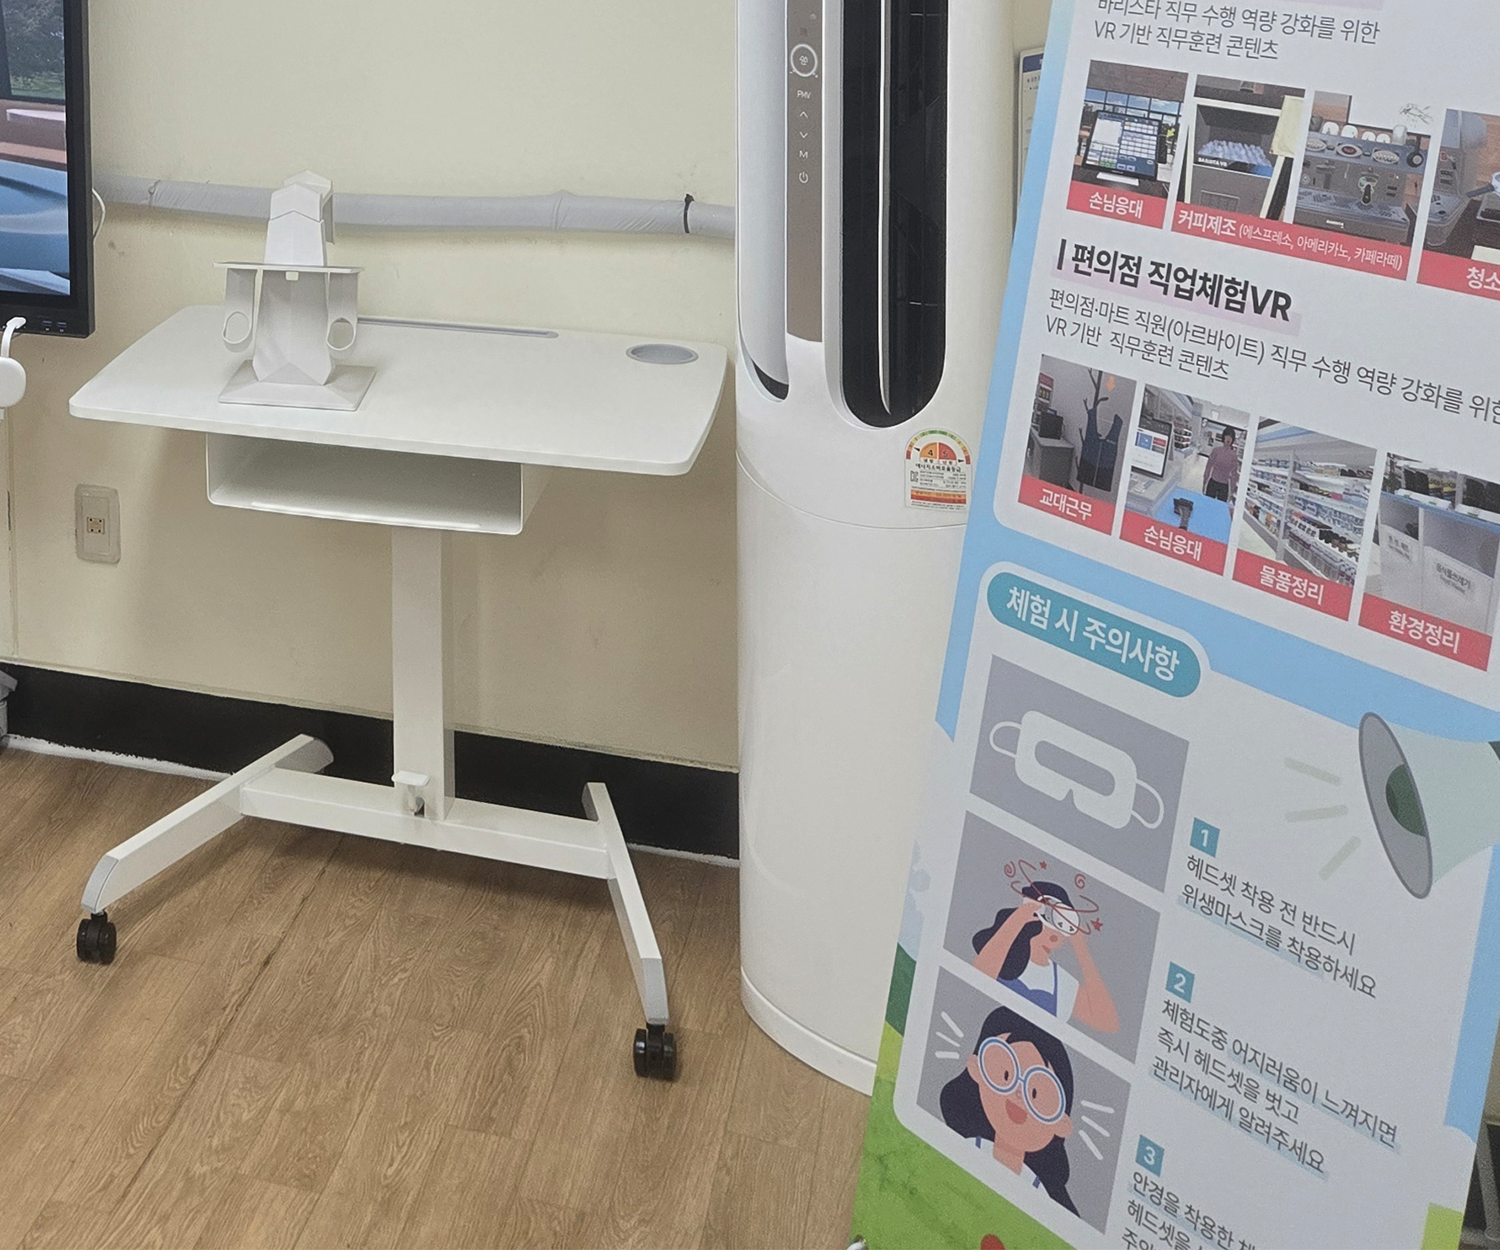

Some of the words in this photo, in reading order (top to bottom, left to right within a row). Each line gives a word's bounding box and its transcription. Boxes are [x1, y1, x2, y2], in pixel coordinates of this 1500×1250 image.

[1094, 20, 1116, 40] VR
[1119, 22, 1152, 46] 기반
[1156, 26, 1221, 54] 직무훈련
[1226, 35, 1278, 60] 콘텐츠
[1165, 0, 1197, 23] 직무
[1201, 5, 1237, 28] 수행
[1240, 8, 1277, 33] 역량
[1280, 12, 1336, 40] 강화를
[1340, 19, 1380, 45] 위한
[1089, 191, 1143, 219] 손님응대
[1178, 209, 1237, 237] 커피제조
[1239, 223, 1294, 250] (에스프레소,
[1297, 235, 1351, 261] 아메리카노,
[1354, 247, 1403, 271] 카페라떼)
[1071, 243, 1142, 288] 편의점
[1147, 260, 1292, 322] 직업체험VR
[1046, 314, 1068, 336] VR
[1070, 321, 1102, 347] 기반
[1109, 331, 1174, 367] 직무훈련
[1177, 350, 1230, 381] 콘텐츠
[1049, 288, 1130, 325] 편의점·마트
[1134, 309, 1265, 366] 직원(아르바이트)
[1270, 344, 1307, 373] 직무
[1312, 355, 1351, 385] 수행
[1356, 366, 1397, 396] 역량
[1401, 377, 1464, 415] 강화를
[1039, 488, 1092, 521] 교대근무
[1143, 524, 1202, 561] 손님응대
[1260, 564, 1324, 605] 물품정리
[1006, 585, 1051, 630] 체험
[1054, 607, 1078, 641] 시
[1082, 616, 1180, 682] 주의사항
[1388, 609, 1460, 654] 환경정리
[1200, 828, 1210, 848] 1
[1186, 853, 1237, 897] 헤드셋
[1240, 881, 1276, 915] 착용
[1279, 899, 1298, 926] 전
[1301, 911, 1355, 956] 반드시
[1181, 883, 1282, 952] 위생마스크를
[1286, 936, 1377, 999] 착용하세요
[1174, 972, 1186, 994] 2
[1156, 1027, 1190, 1062] 즉시
[1194, 1048, 1261, 1103] 헤드셋을
[1265, 1090, 1299, 1124] 벗고
[1161, 999, 1228, 1050] 체험도중
[1231, 1039, 1318, 1104] 어지러움이
[1320, 1090, 1397, 1150] 느껴지면
[1152, 1055, 1234, 1121] 관리자에게
[1238, 1106, 1325, 1174] 알려주세요
[1143, 1146, 1155, 1165] 3
[1133, 1171, 1180, 1218] 안경을
[1184, 1204, 1235, 1250] 착용한
